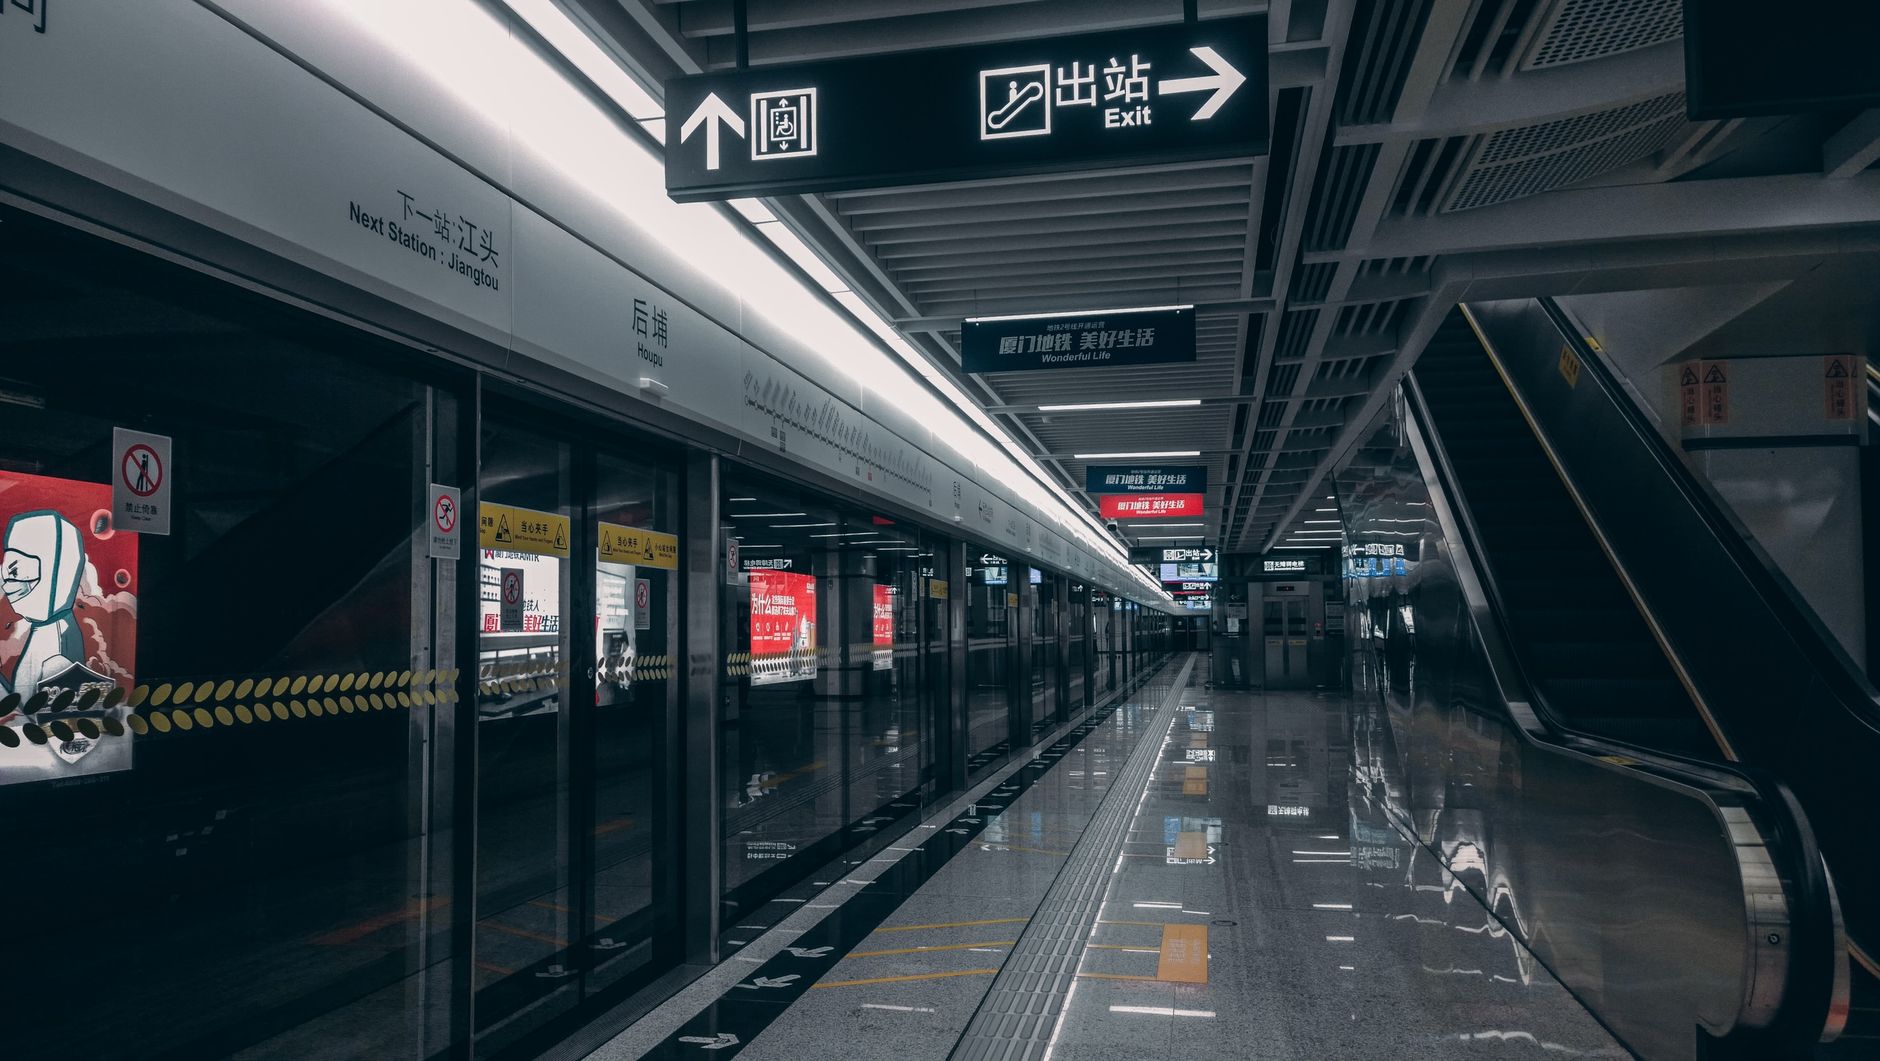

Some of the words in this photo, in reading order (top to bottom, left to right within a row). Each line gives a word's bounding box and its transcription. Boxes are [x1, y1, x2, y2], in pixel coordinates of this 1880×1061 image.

[1056, 54, 1151, 107] 出站
[1104, 105, 1152, 129] Exit
[350, 201, 384, 236] Next
[388, 221, 436, 261] Station
[448, 252, 499, 292] Jiangtou
[632, 298, 668, 349] 后埔
[999, 333, 1073, 355] 厦门地铁
[1079, 328, 1155, 351] 美好生活
[637, 341, 663, 368] Houpu
[1042, 353, 1091, 363] Wonderful
[1093, 351, 1111, 361] Life
[1105, 474, 1145, 485] 厦门地铁
[1147, 474, 1187, 485] 美好生活
[521, 520, 549, 535] 当心夹手
[617, 535, 638, 548] 当心夹手
[751, 592, 771, 615] 为什么
